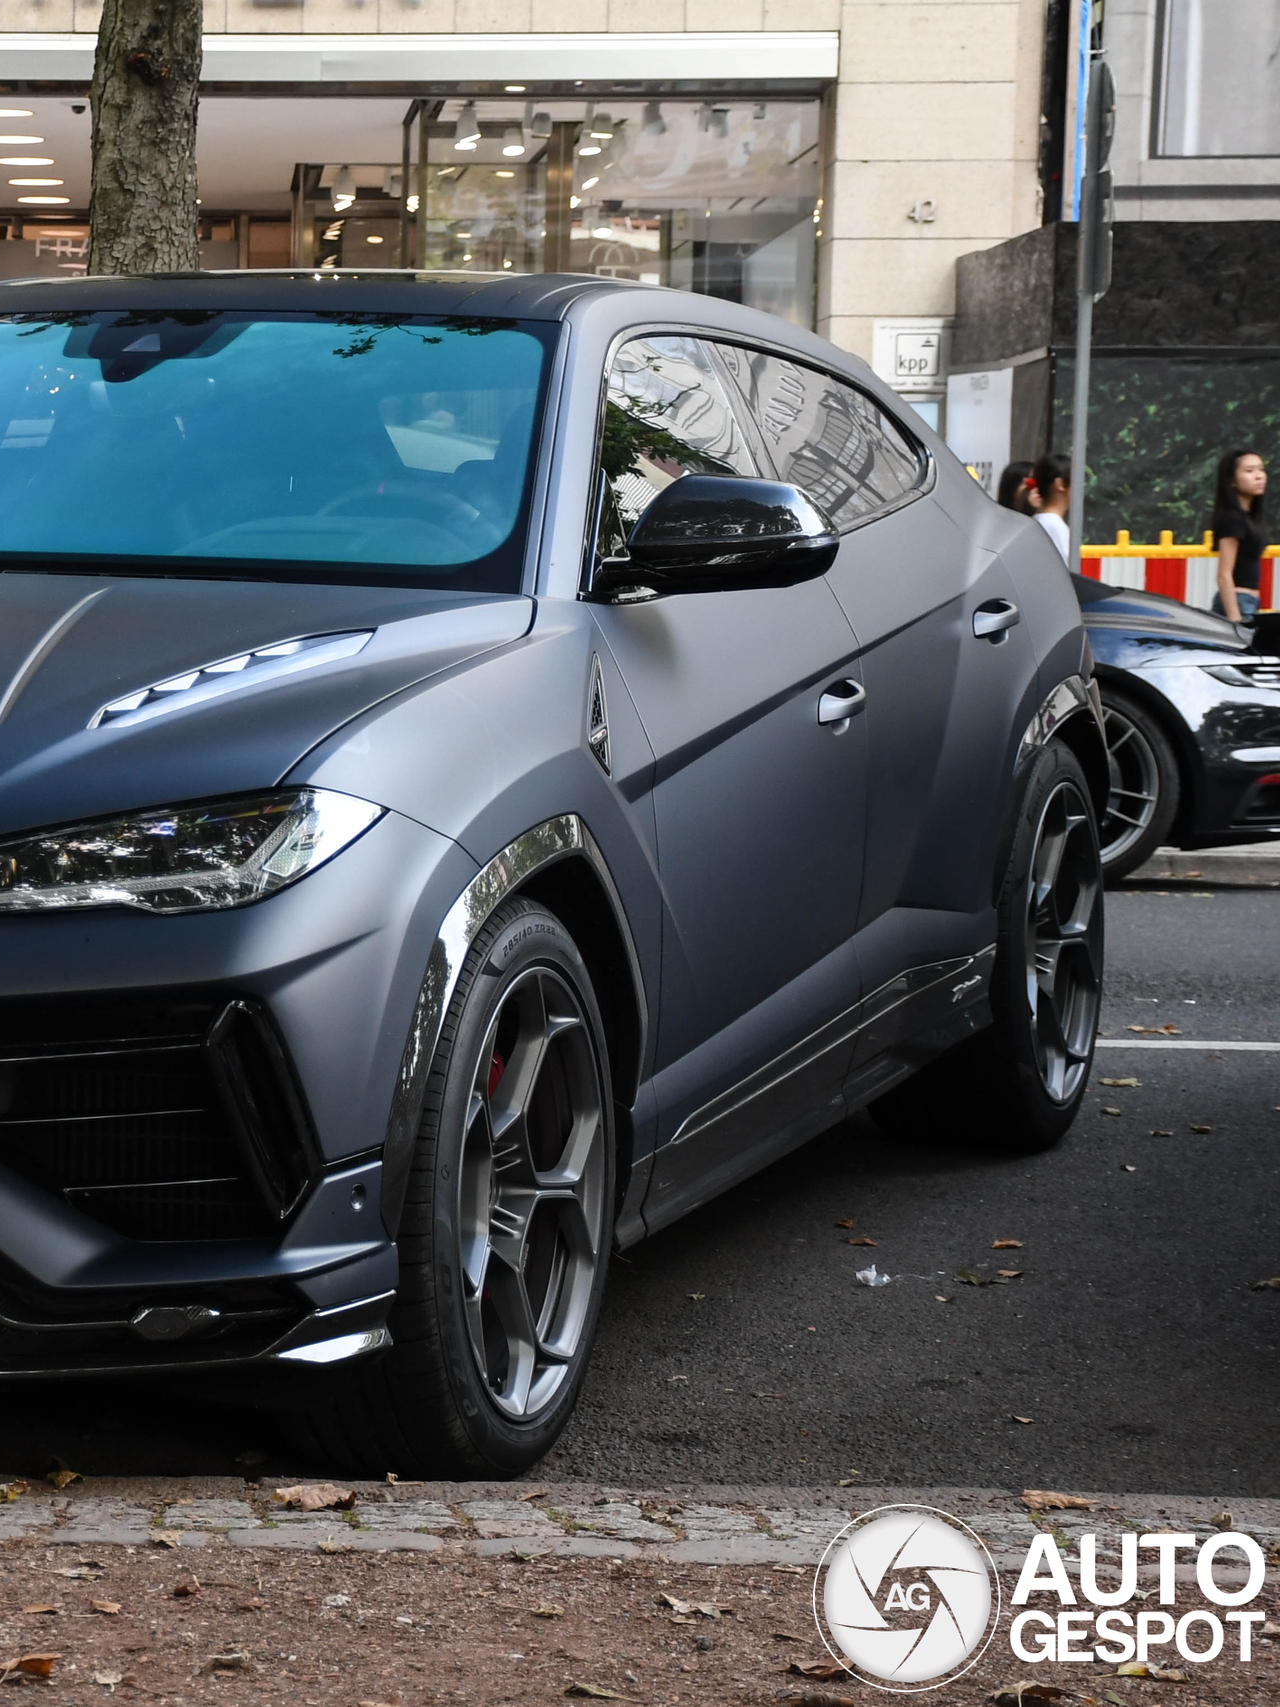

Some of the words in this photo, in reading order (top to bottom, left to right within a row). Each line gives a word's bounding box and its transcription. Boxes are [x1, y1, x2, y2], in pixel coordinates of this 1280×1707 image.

[906, 198, 936, 223] 42
[899, 354, 928, 373] kpp
[502, 926, 533, 958] 285/40
